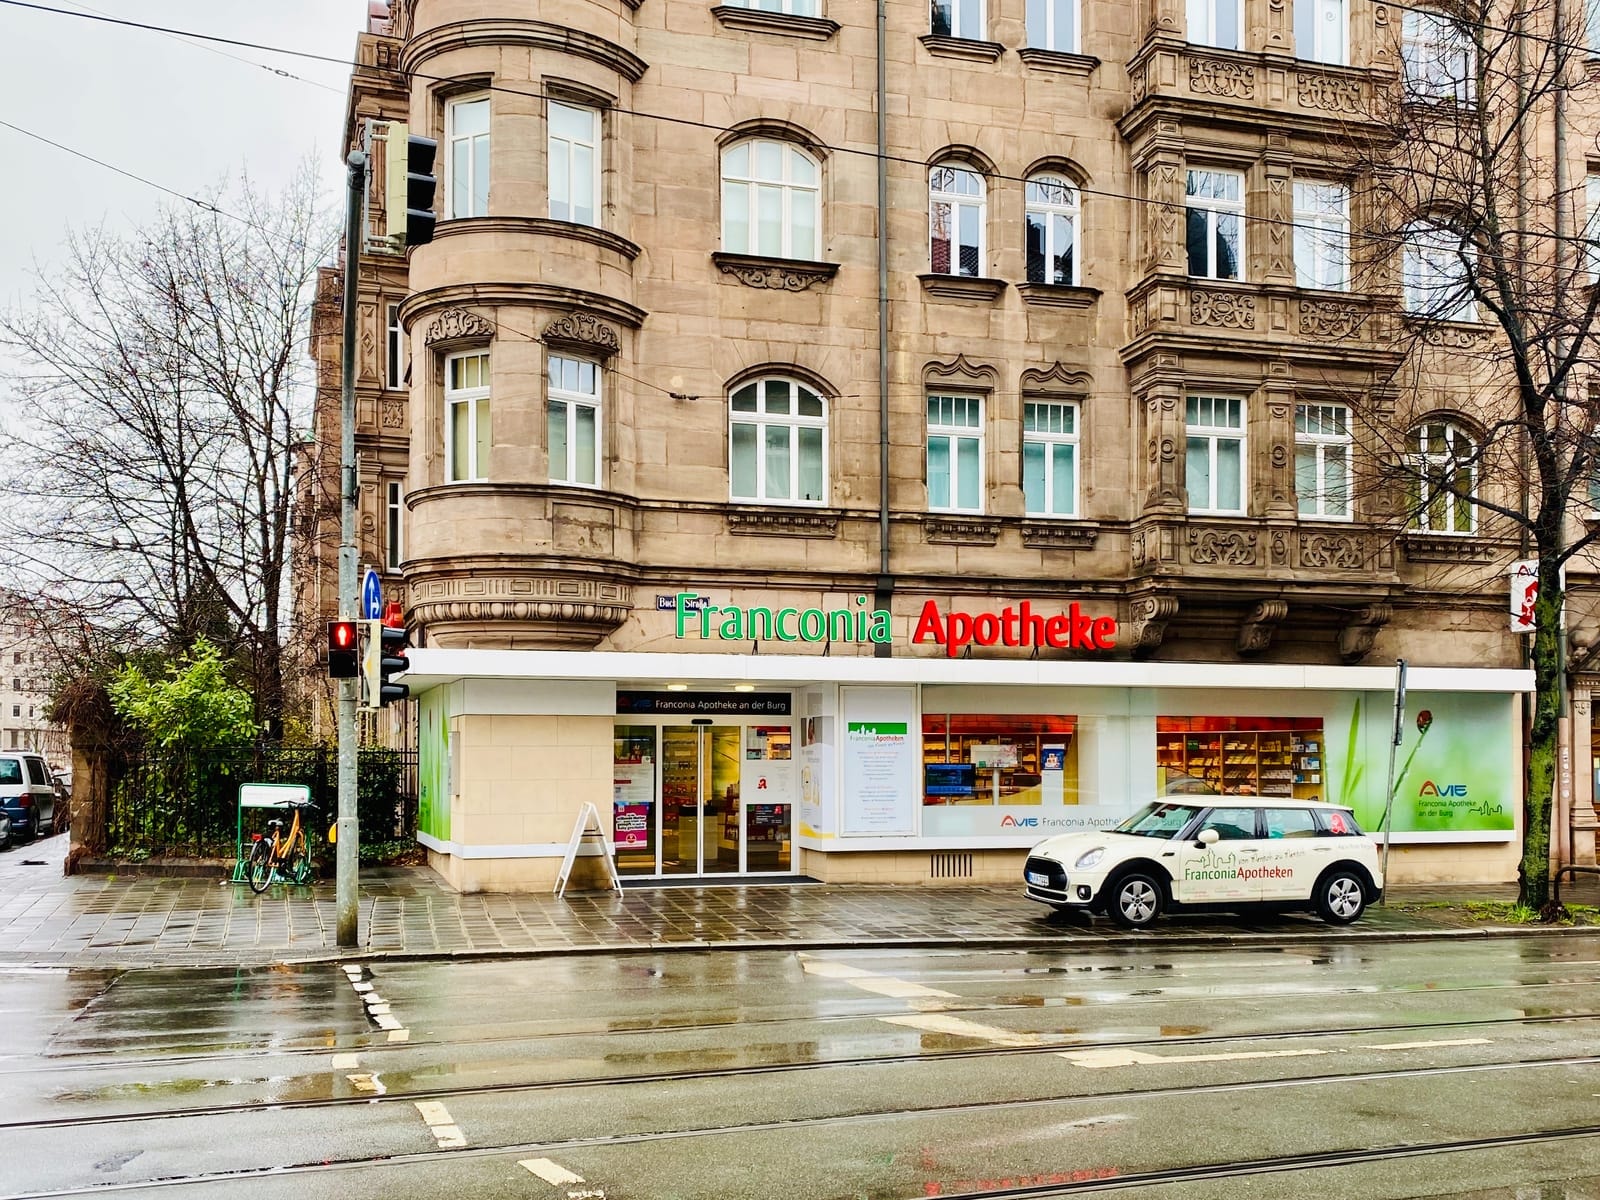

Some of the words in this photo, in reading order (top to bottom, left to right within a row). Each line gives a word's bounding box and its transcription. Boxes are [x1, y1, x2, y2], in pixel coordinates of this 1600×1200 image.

[676, 593, 893, 643] Franconia
[912, 599, 1117, 657] Apotheke
[655, 700, 696, 709] Franconia
[698, 700, 737, 711] Apotheke
[751, 700, 765, 710] der
[767, 701, 786, 711] Burg
[1418, 780, 1468, 797] AVIE
[1448, 800, 1477, 808] Apotheke
[1438, 810, 1454, 818] Burg
[1000, 815, 1038, 827] AVIE
[1042, 817, 1085, 827] Franconia
[1087, 817, 1120, 829] Apothe
[1185, 865, 1293, 881] FranconiaApotheken
